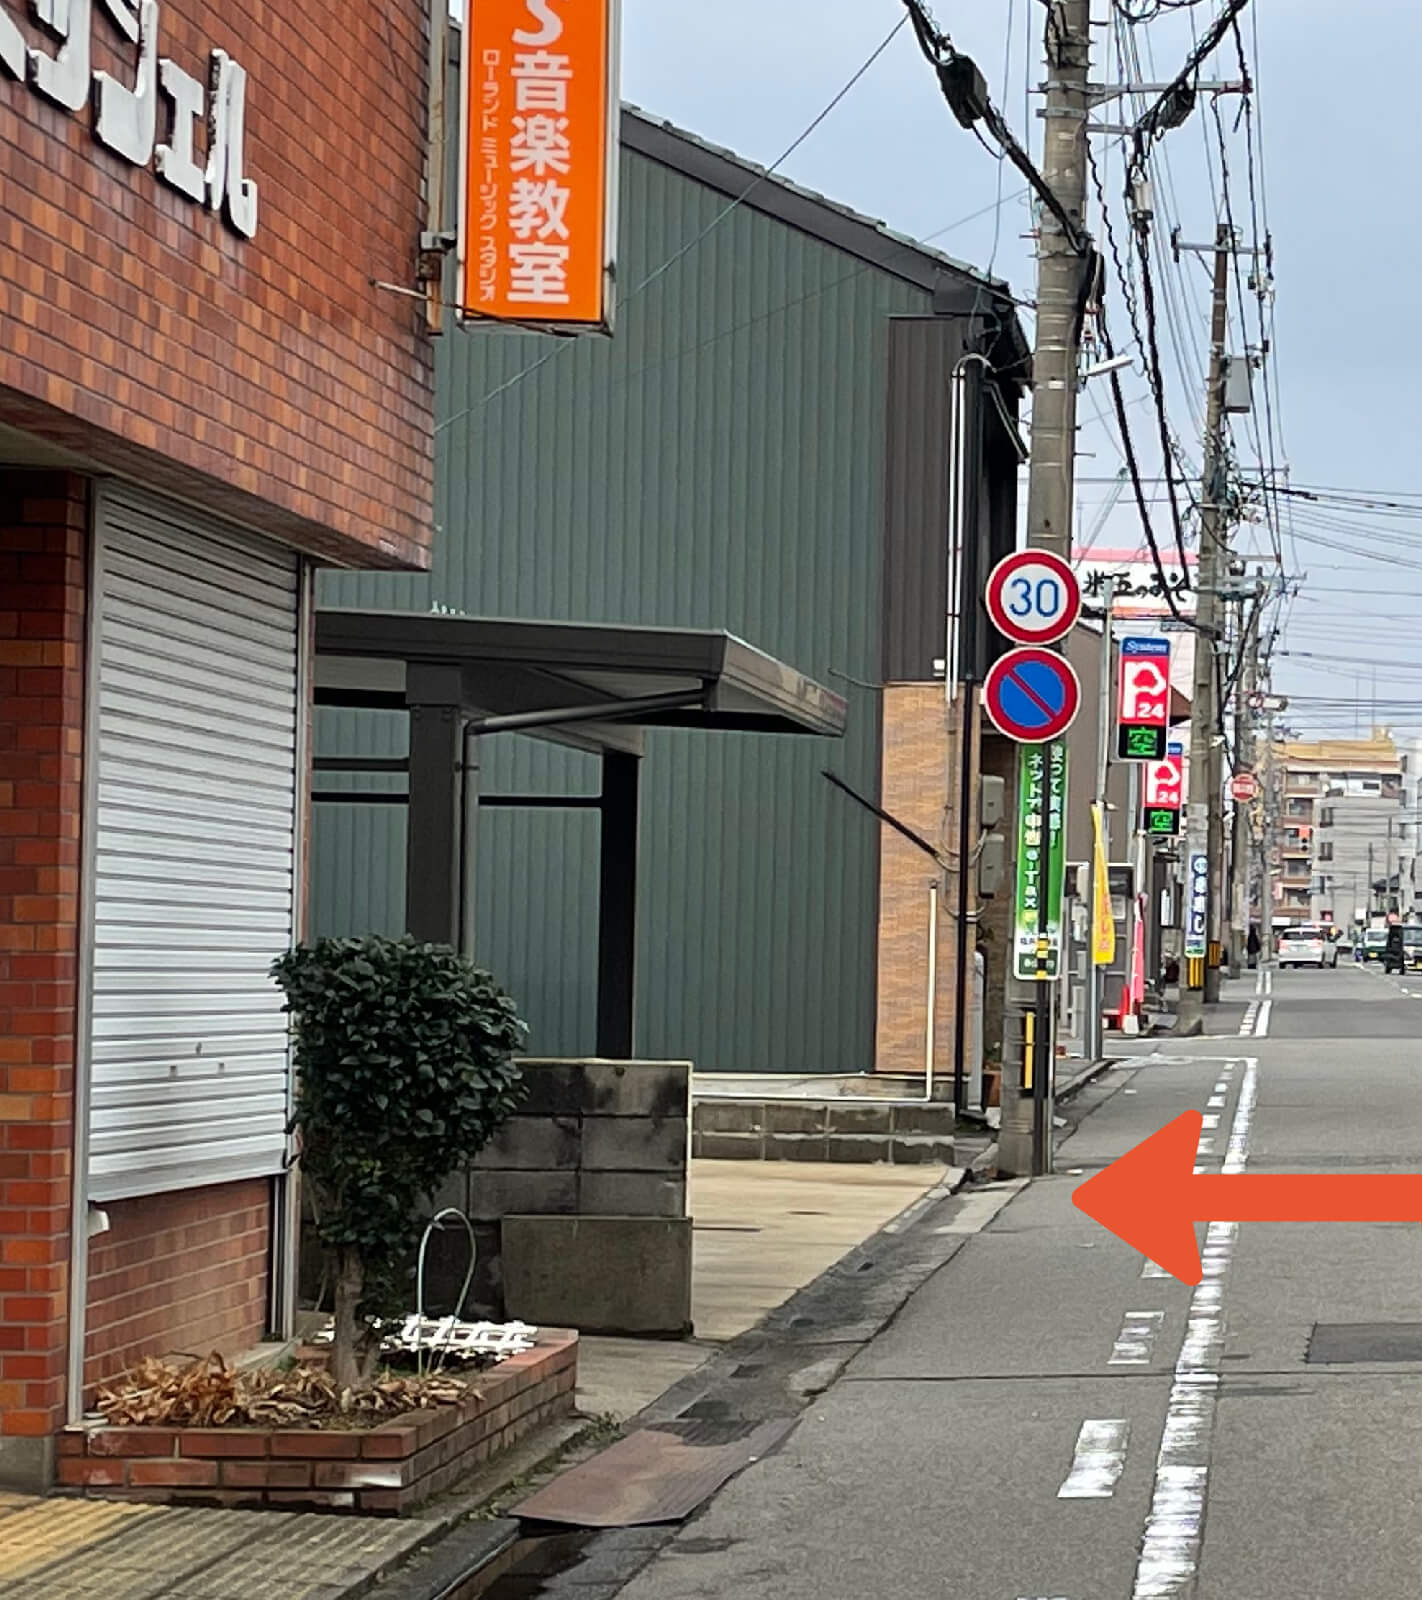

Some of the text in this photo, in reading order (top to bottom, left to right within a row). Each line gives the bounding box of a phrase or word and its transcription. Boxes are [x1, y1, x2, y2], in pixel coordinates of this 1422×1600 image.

[0, 0, 257, 238] ッシェル
[480, 50, 499, 301] ローランド ミュージック スタジオ
[1009, 578, 1060, 617] 30
[1136, 702, 1165, 718] 24
[1127, 726, 1157, 756] 空
[1157, 791, 1180, 804] 24
